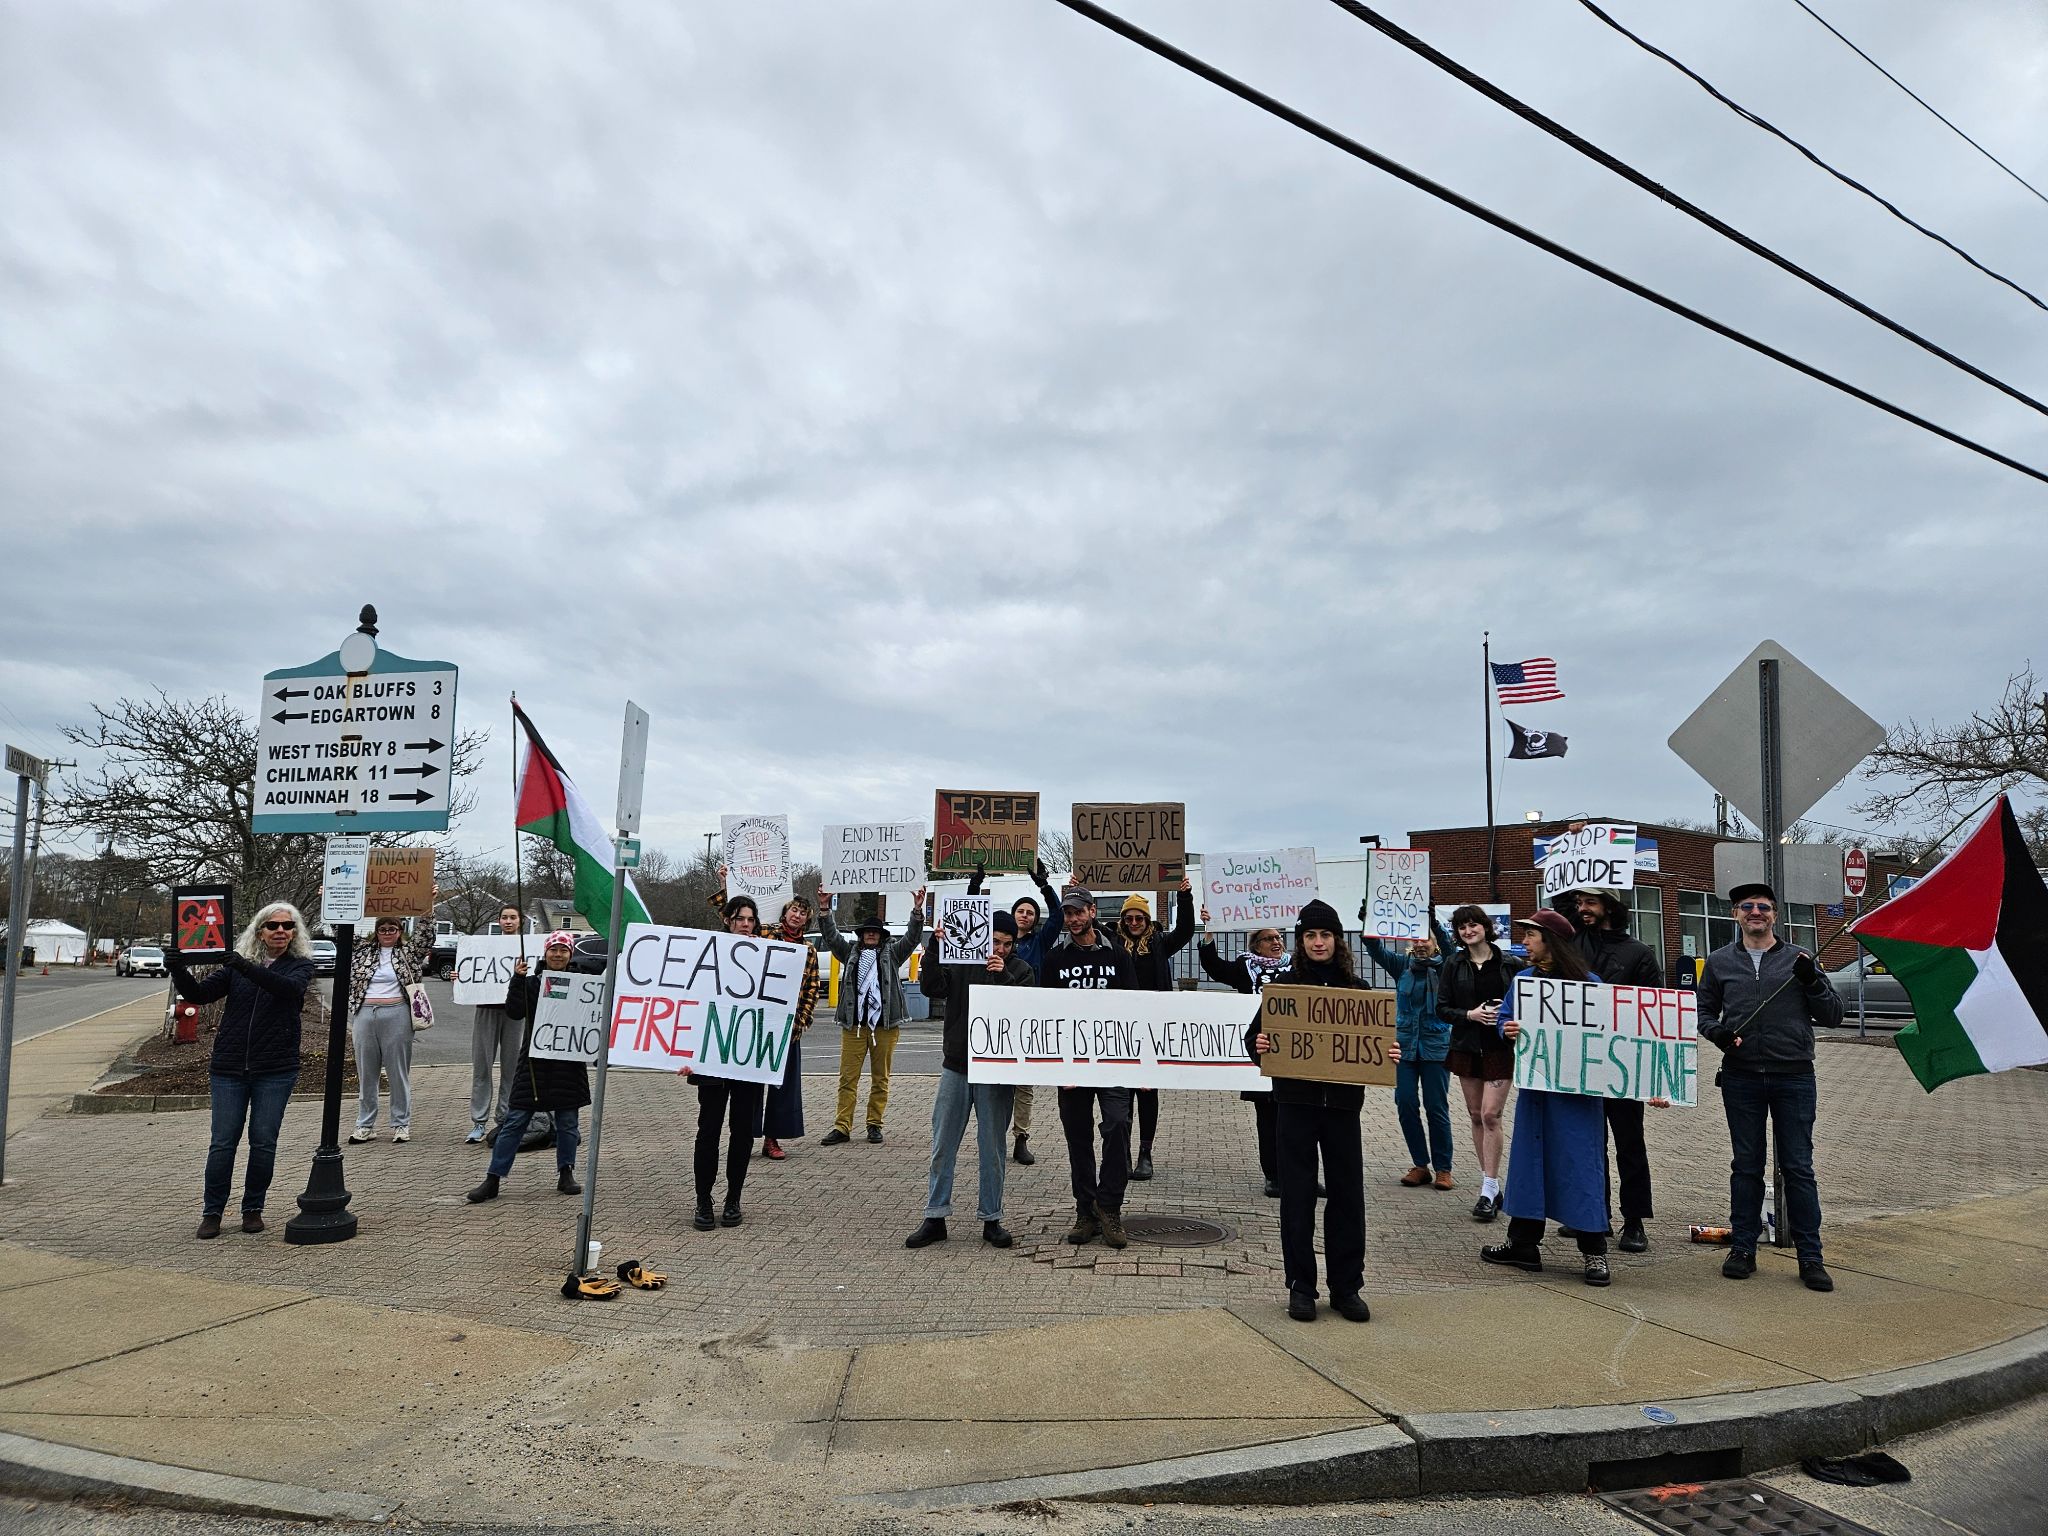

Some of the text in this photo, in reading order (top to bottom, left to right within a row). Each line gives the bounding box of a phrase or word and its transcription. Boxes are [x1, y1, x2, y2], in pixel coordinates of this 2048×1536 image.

[314, 680, 442, 700] OAK BLUFFS 3
[311, 704, 441, 724] EDGARTOWN 8
[268, 741, 397, 760] WEST TISBURY 8
[266, 765, 388, 783] CHILMARK 11
[265, 789, 379, 805] AQUINNAH 18
[950, 796, 1030, 825] FREE
[745, 818, 780, 836] VIOLENCE
[842, 825, 905, 843] END THE
[1076, 811, 1181, 841] CEASEFIRE
[744, 832, 769, 847] STOP
[1561, 826, 1607, 853] STOP
[747, 849, 769, 862] THE
[840, 848, 902, 864] ZIONIST
[939, 833, 1031, 868] PALESTINE
[1106, 841, 1151, 859] NOW
[1571, 847, 1587, 856] THE
[779, 842, 790, 883] VIOLENCE
[1222, 856, 1281, 877] Jewish
[1375, 853, 1425, 872] STOP
[1848, 857, 1865, 865] DO NOT
[366, 870, 419, 885] ILDREN
[740, 864, 778, 878] MURDER
[830, 866, 916, 886] APARTHEID
[1078, 864, 1151, 884] SAVE GAZA
[1388, 872, 1412, 885] the
[1545, 858, 1628, 893] GENOCIDE
[377, 885, 397, 895] NOT
[1211, 873, 1313, 895] Grandmother
[1850, 878, 1863, 887] ENTER
[1248, 892, 1269, 907] for
[1376, 885, 1424, 901] GAZA
[365, 897, 423, 913] ATERAL
[944, 900, 989, 918] LIBERATE
[1376, 920, 1421, 939] CIDE
[943, 942, 989, 960] PALESTINE
[626, 934, 797, 1005] CEASE
[1059, 965, 1116, 979] NOT IN
[579, 981, 605, 1003] ST
[1069, 977, 1108, 989] OUR
[1267, 997, 1396, 1027] OUR IGNORANCE
[1517, 979, 1696, 1042] FREE, FREE
[533, 1023, 600, 1055] GENO
[700, 1001, 795, 1072] NOW
[970, 1015, 1252, 1059] OUR GRIEF IS BEING WEAPONIZE
[1266, 1031, 1384, 1066] IS BB's BLISS
[1515, 1027, 1697, 1104] PALESTINE
